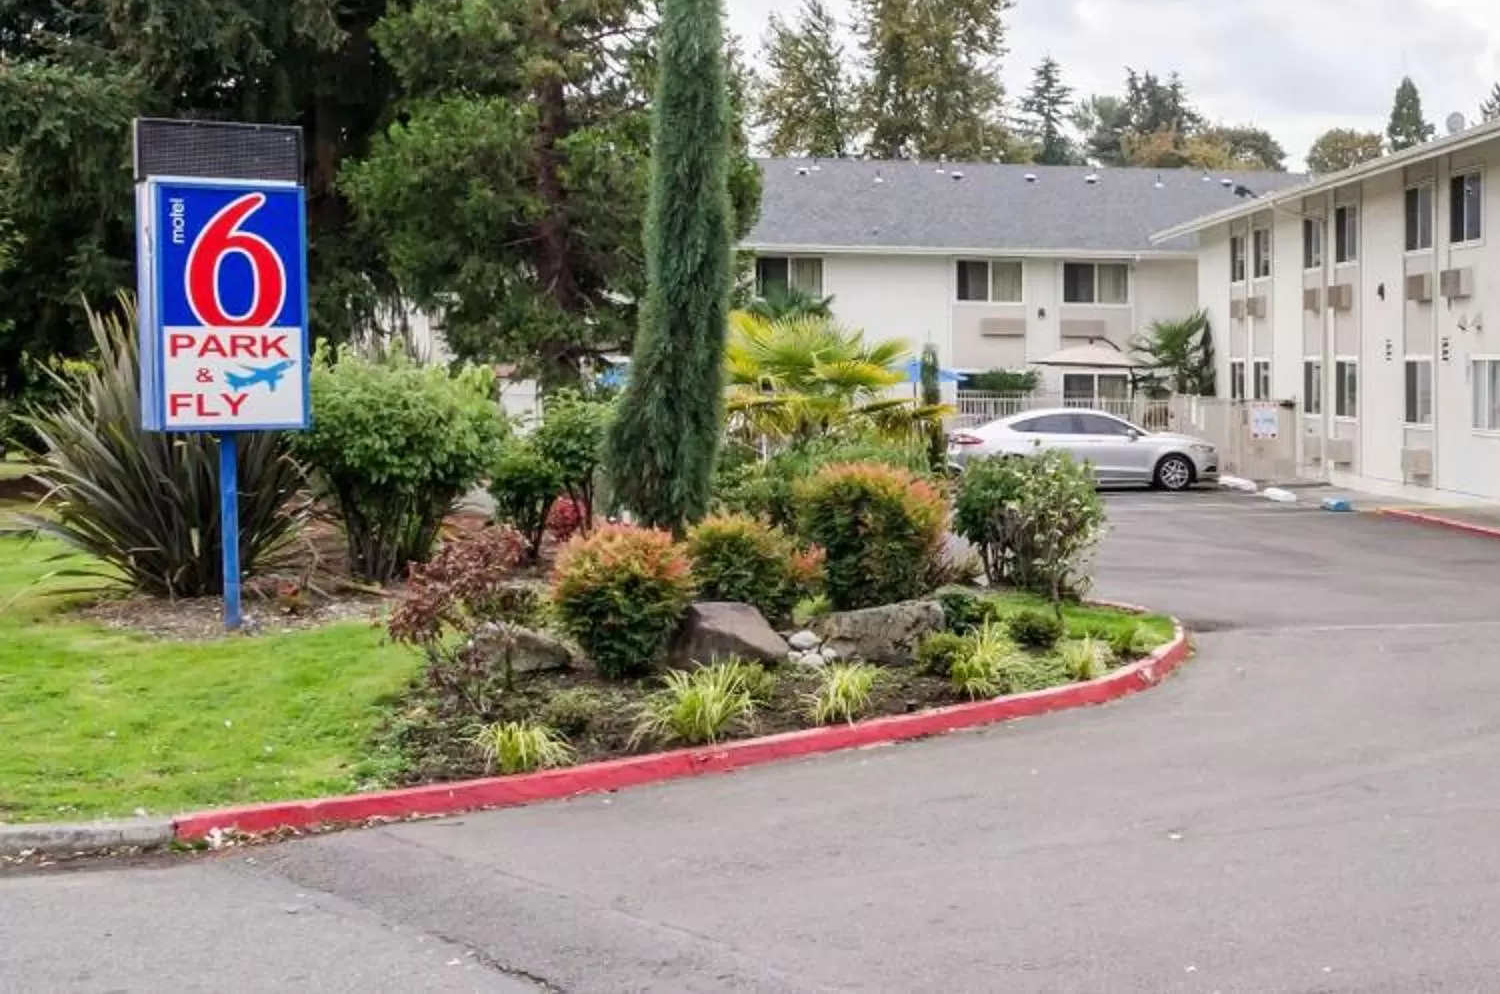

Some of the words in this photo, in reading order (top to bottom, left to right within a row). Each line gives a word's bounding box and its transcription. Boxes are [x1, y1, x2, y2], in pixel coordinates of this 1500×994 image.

[169, 197, 184, 244] motel
[185, 192, 287, 327] 6
[169, 334, 289, 358] PARK
[196, 367, 214, 383] &
[169, 393, 249, 417] FLY
